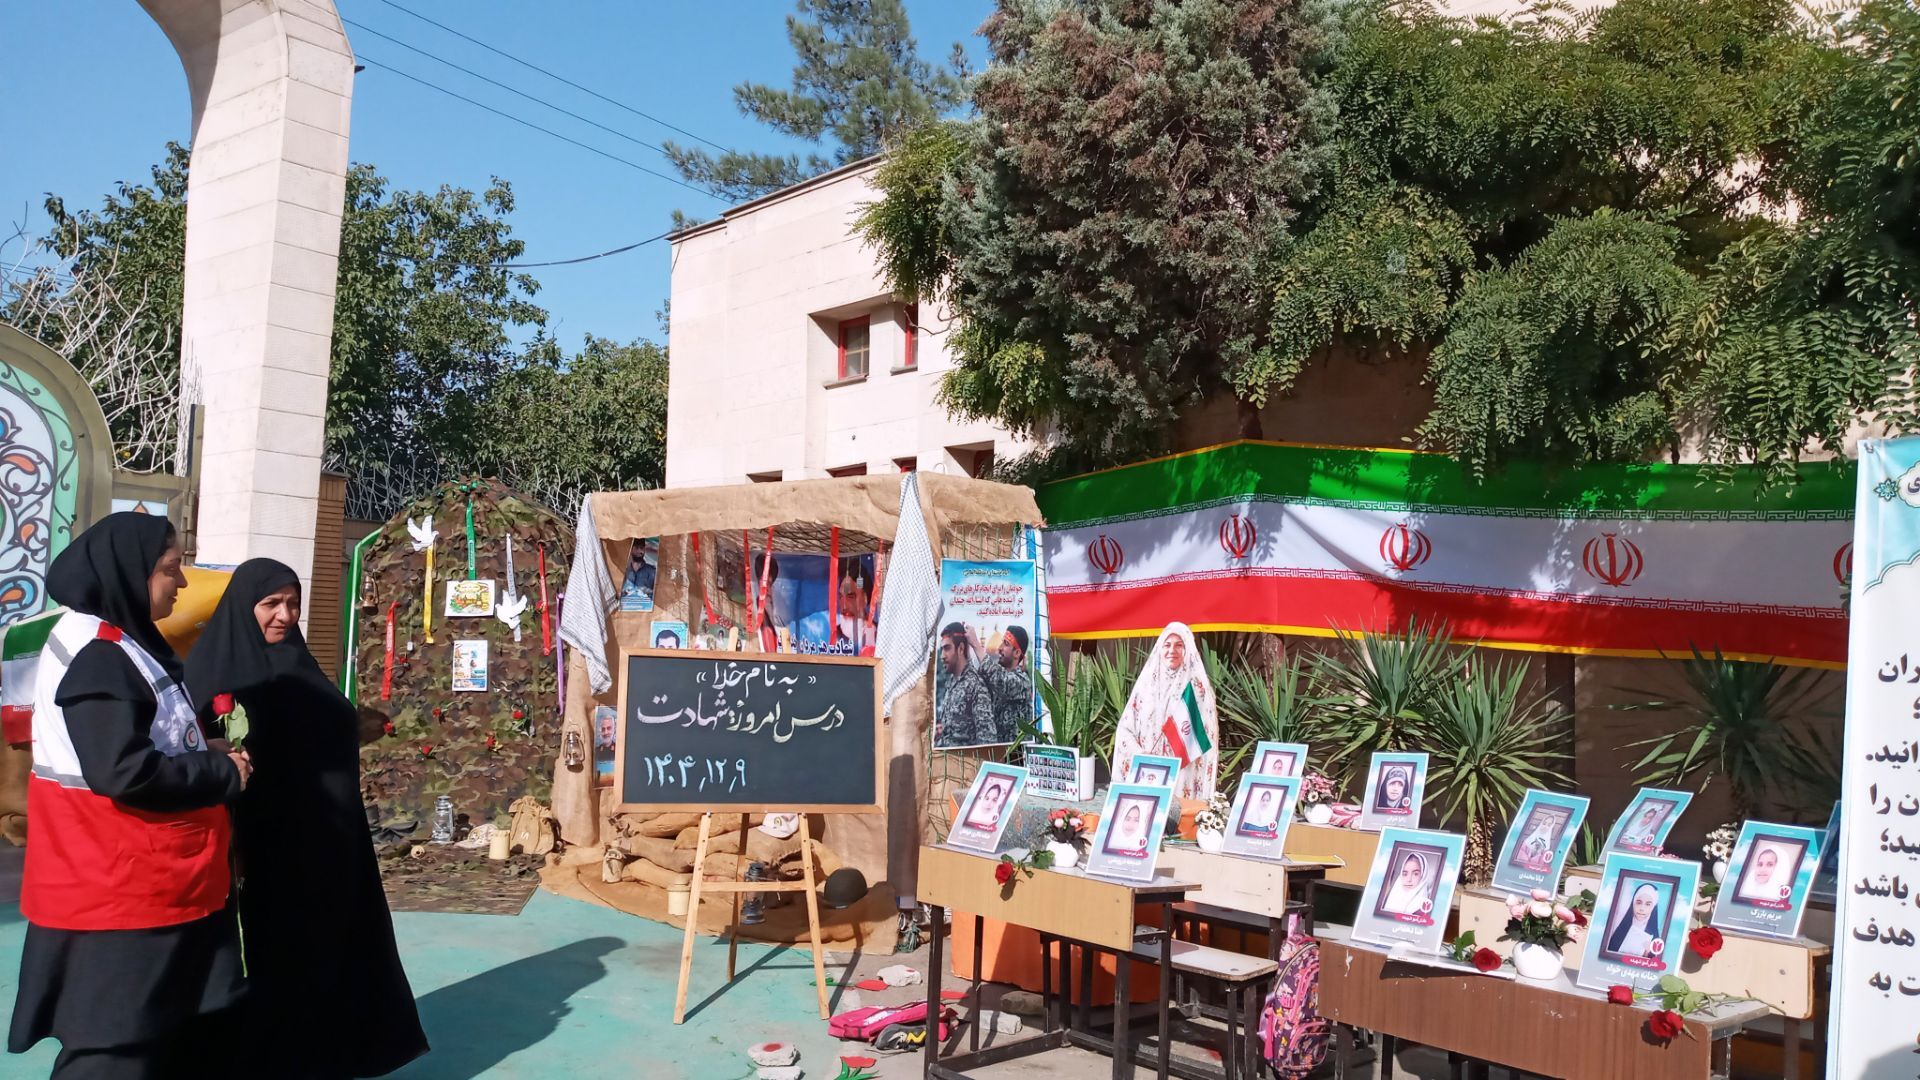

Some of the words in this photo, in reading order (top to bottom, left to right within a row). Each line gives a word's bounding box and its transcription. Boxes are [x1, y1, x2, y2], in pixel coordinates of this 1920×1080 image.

[711, 662, 745, 690] خدا
[745, 663, 777, 698] نام
[637, 691, 730, 731] شهادت
[773, 703, 845, 743] درس
[1869, 783, 1891, 815] را
[1854, 874, 1909, 907] باشد
[1853, 917, 1916, 948] هدف
[1868, 971, 1892, 998] به
